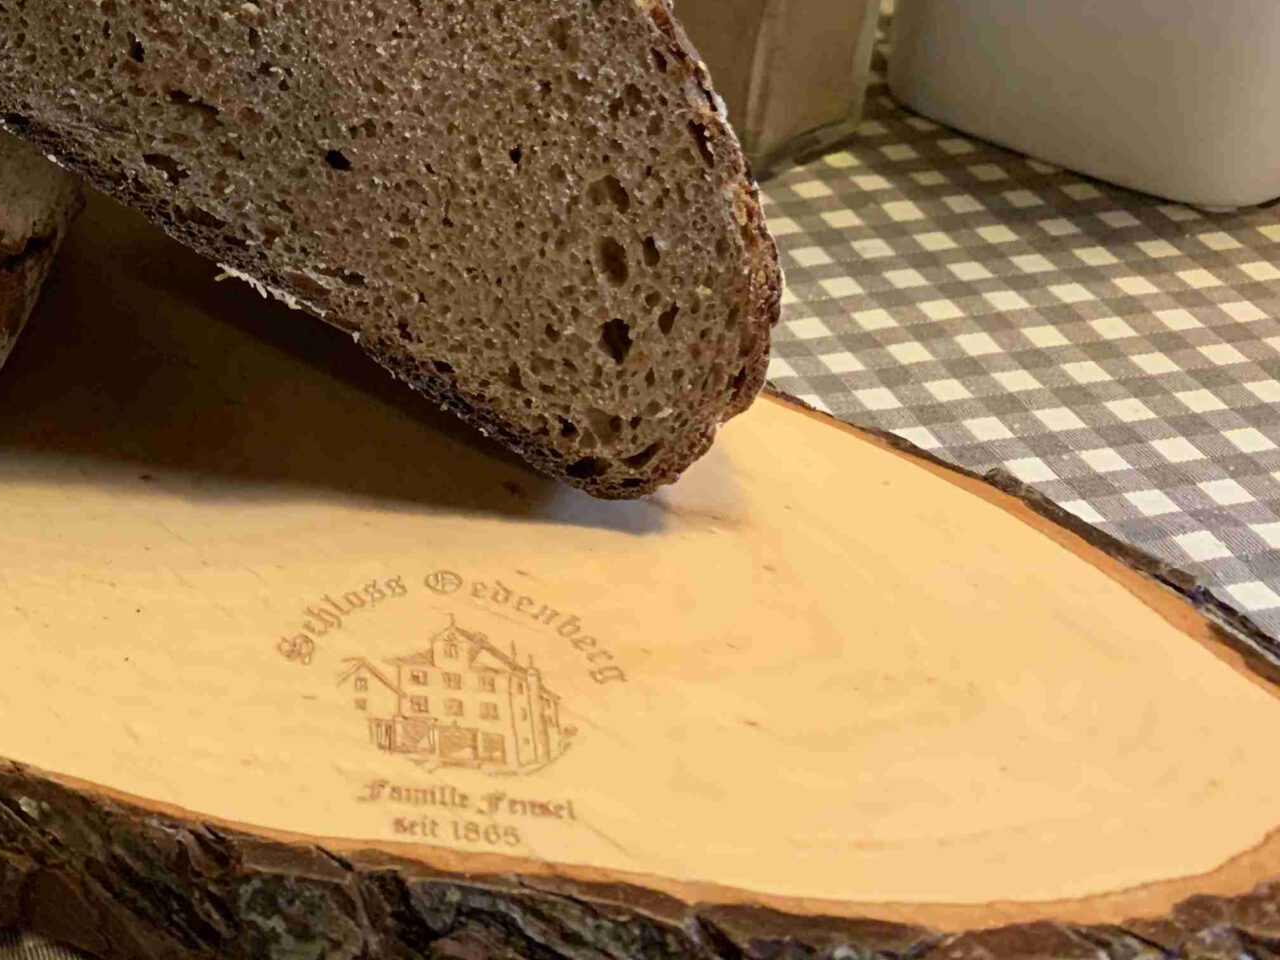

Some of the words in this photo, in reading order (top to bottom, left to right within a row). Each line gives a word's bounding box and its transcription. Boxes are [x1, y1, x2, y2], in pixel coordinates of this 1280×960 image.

[277, 574, 408, 666] Schloss
[393, 814, 440, 839] seit
[450, 820, 522, 848] 1865
